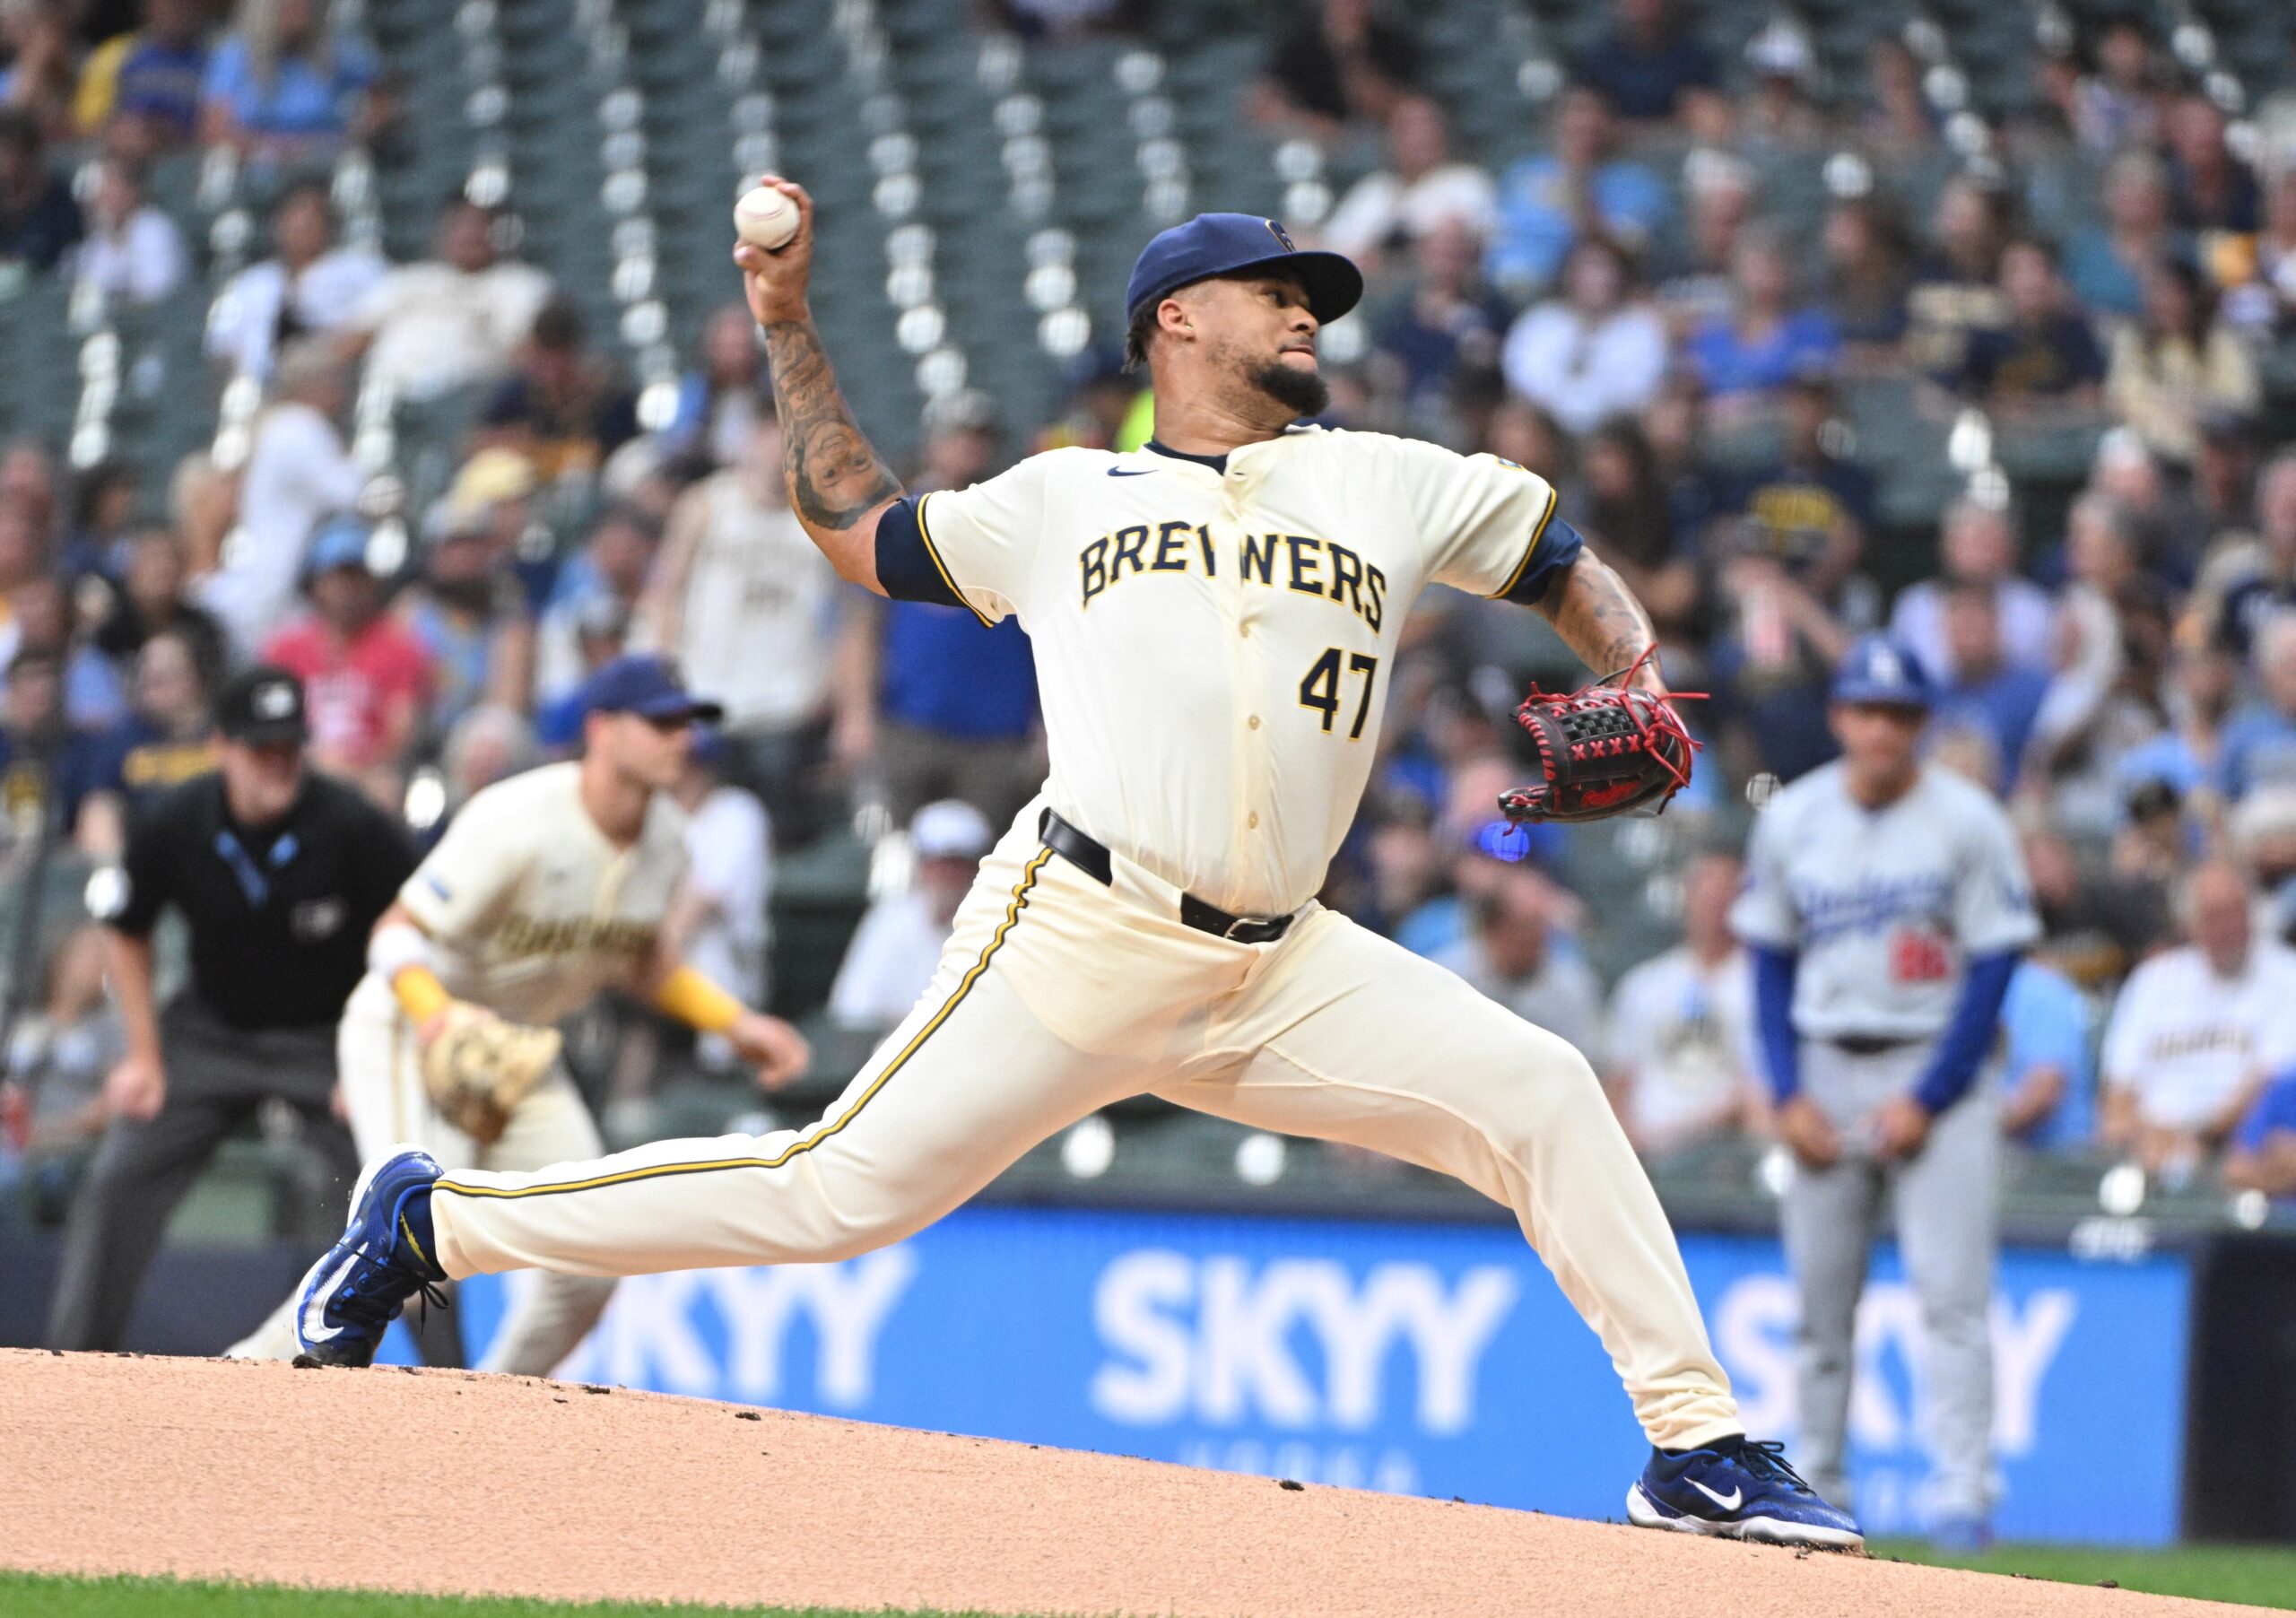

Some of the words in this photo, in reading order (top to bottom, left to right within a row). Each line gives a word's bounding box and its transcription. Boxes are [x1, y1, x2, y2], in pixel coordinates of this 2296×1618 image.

[1080, 519, 1387, 638] BREWERS
[1298, 647, 1378, 743] 47
[1091, 1249, 1520, 1434] SKYY
